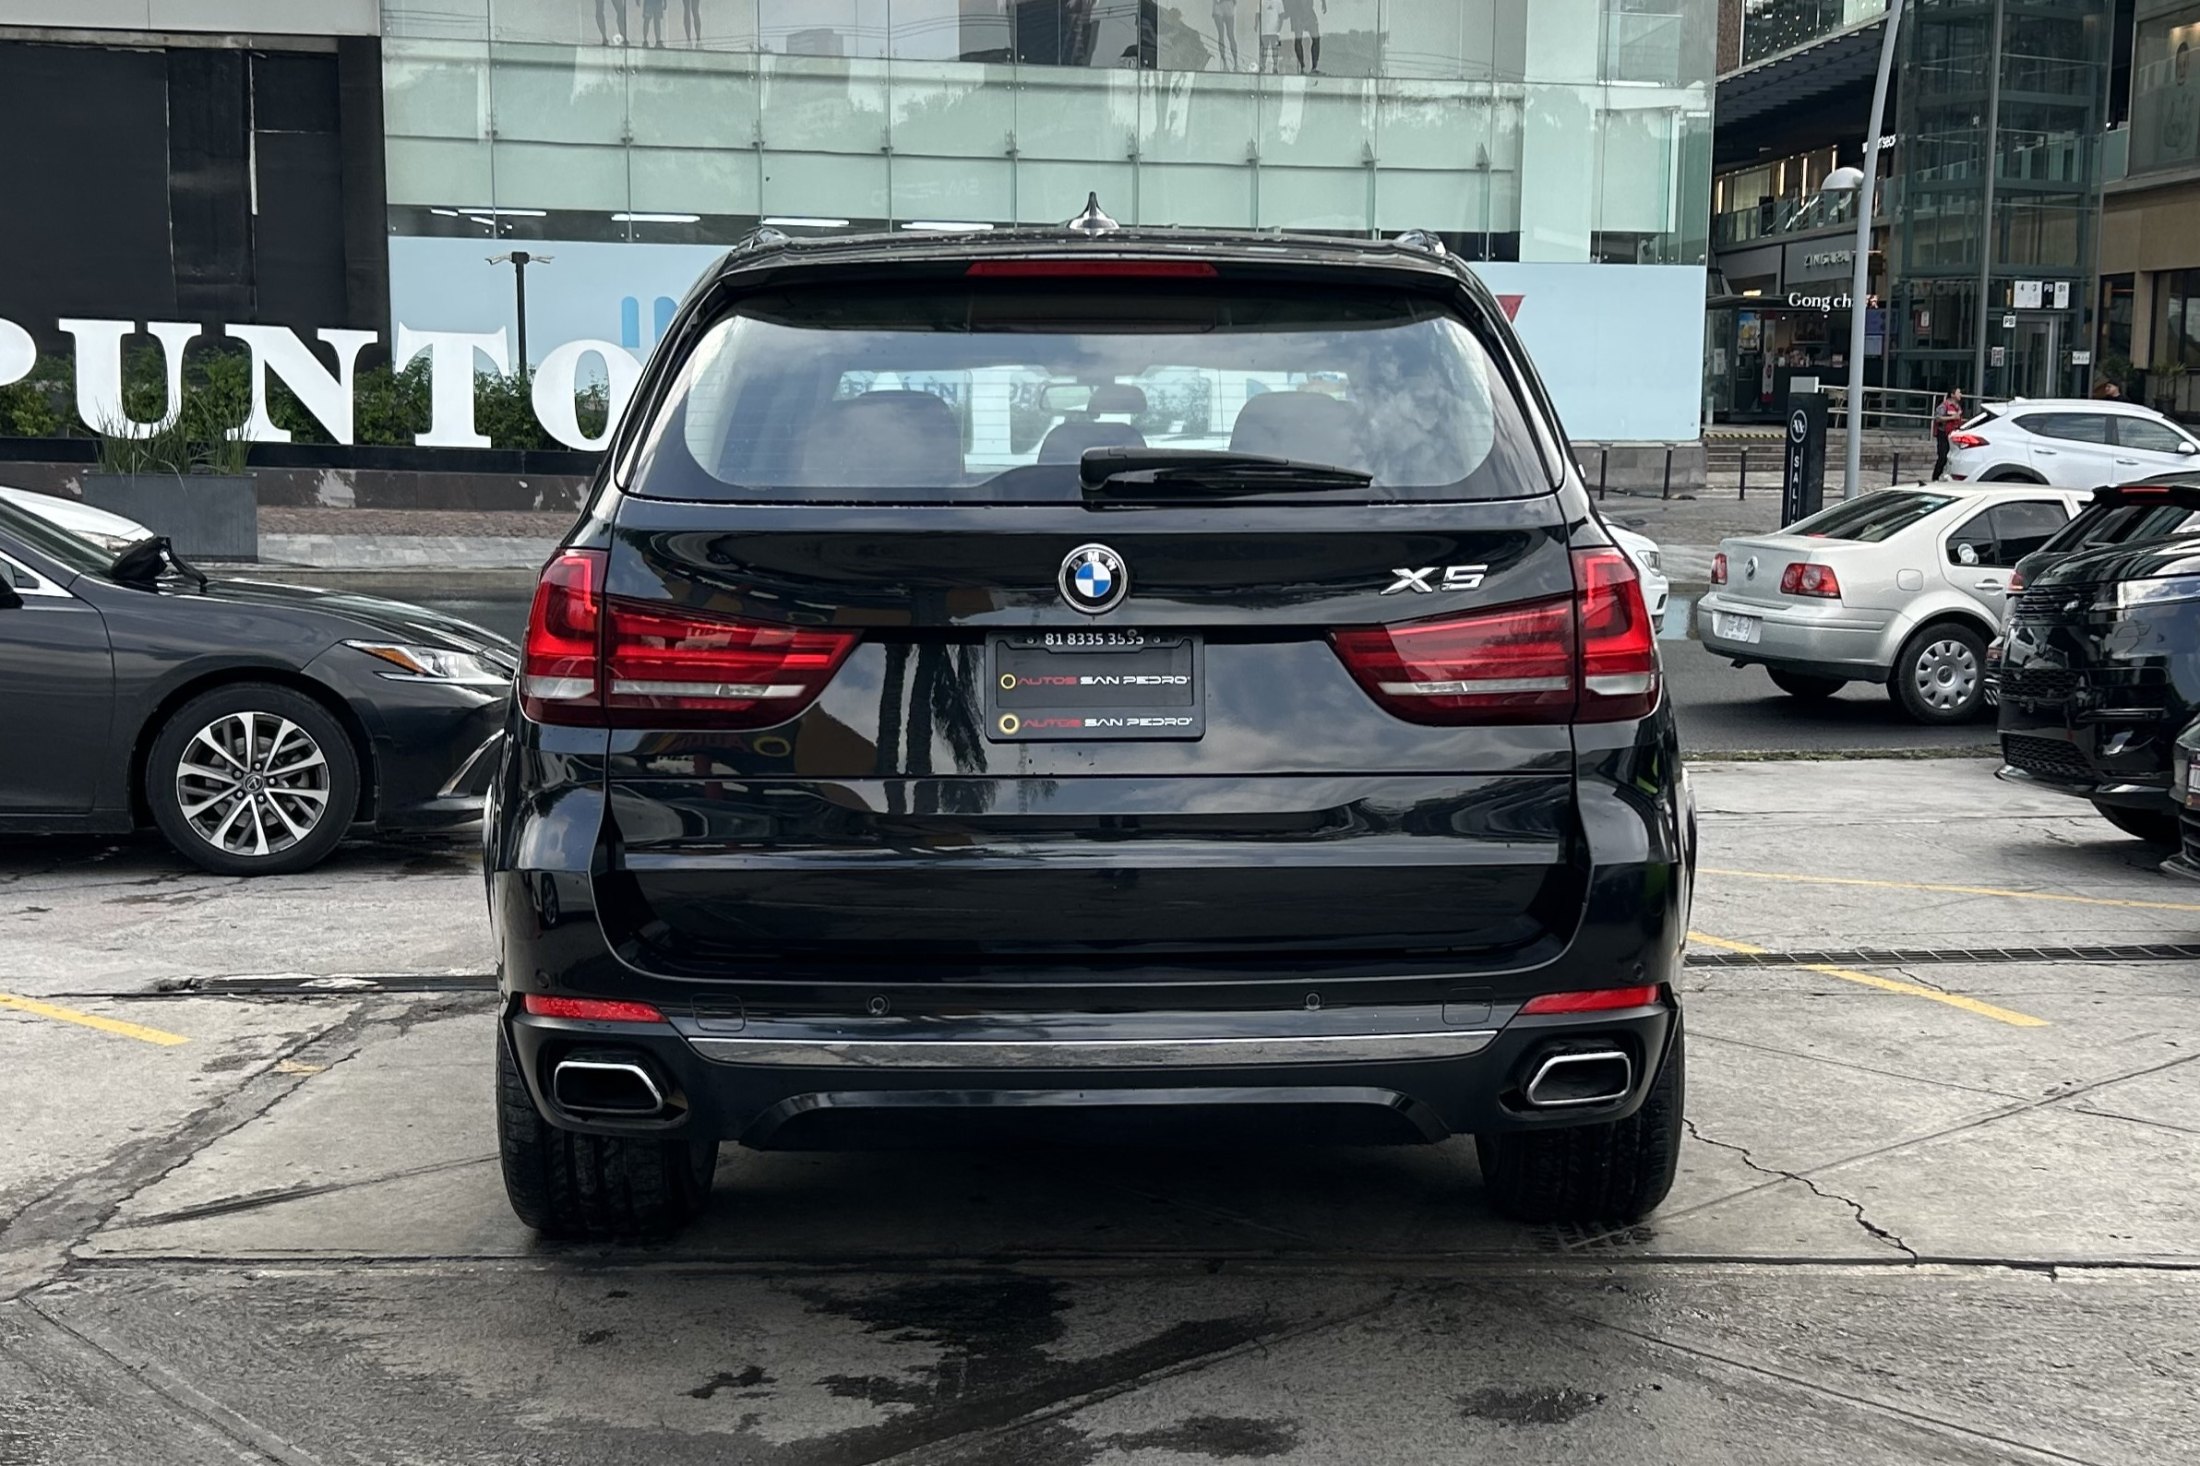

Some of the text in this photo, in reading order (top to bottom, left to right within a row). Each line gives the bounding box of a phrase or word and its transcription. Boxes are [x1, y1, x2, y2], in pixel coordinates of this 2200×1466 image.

[1788, 292, 1831, 312] Gong
[1833, 293, 1854, 308] ch
[1380, 564, 1489, 595] X5
[1045, 633, 1063, 646] 81
[1067, 633, 1104, 646] 8335
[1018, 676, 1188, 686] AUTOS SAN PEDRO
[1022, 717, 1188, 728] AUTOS SAN PEDRO
